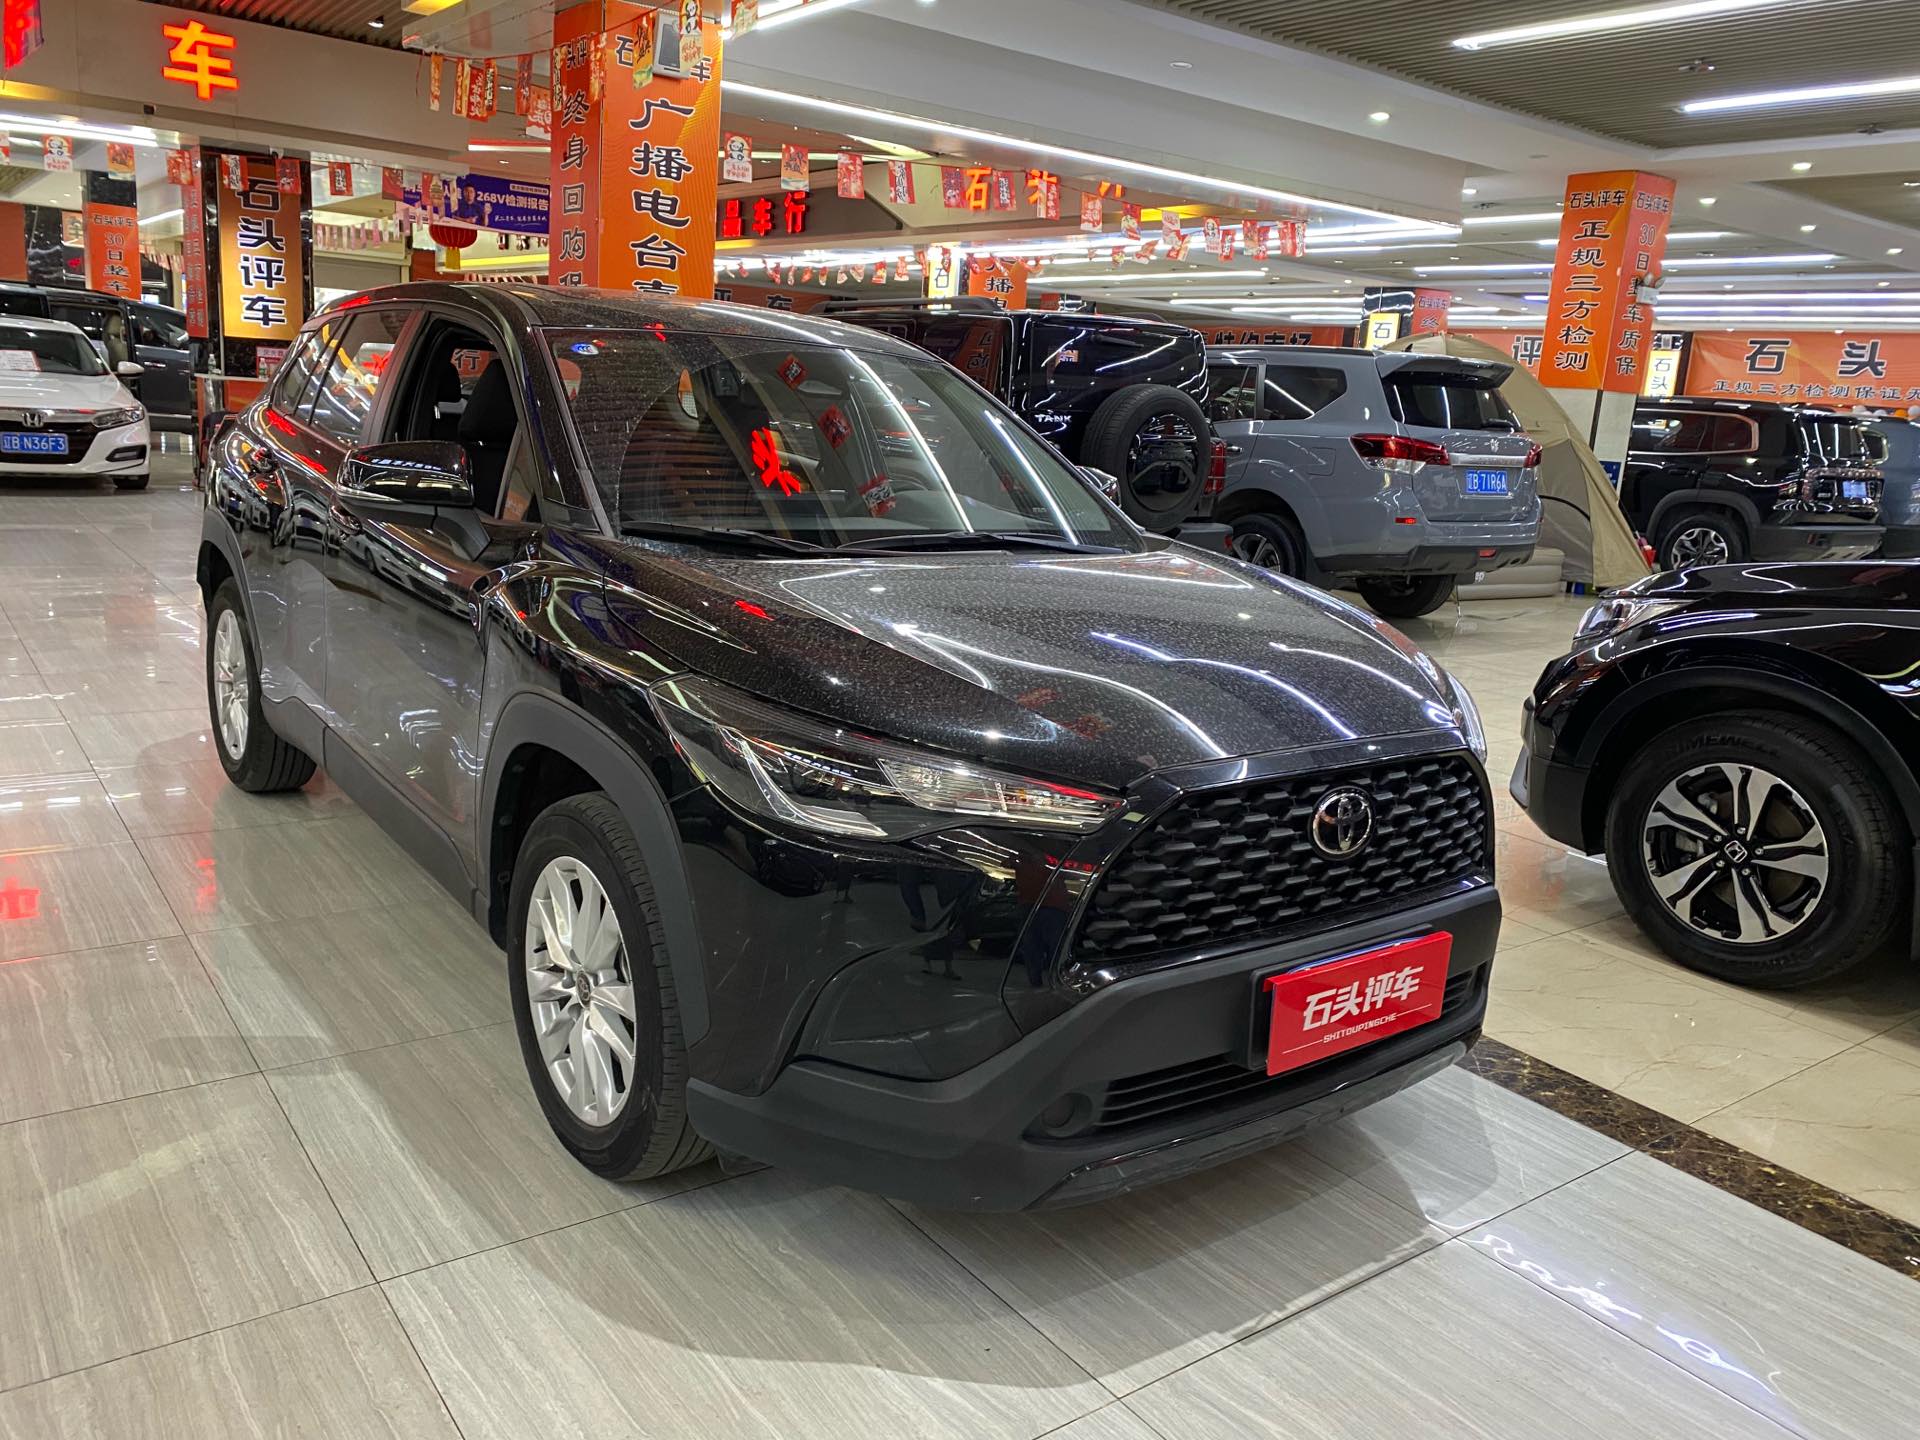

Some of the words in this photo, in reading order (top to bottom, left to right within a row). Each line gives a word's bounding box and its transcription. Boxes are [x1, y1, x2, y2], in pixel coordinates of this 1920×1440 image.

[163, 20, 238, 99] 车
[616, 36, 712, 81] 石车
[477, 191, 549, 211] 268V检测报告
[1570, 190, 1625, 209] 石头评车
[236, 177, 286, 327] 石头评车
[1555, 221, 1610, 370] 正规三方检测
[1652, 358, 1672, 398] 石头
[1744, 338, 1888, 379] 石头
[1034, 413, 1072, 422] TANK
[1303, 966, 1424, 1031] 石头评车
[1323, 1012, 1397, 1044] SHITOUPINGCHE
